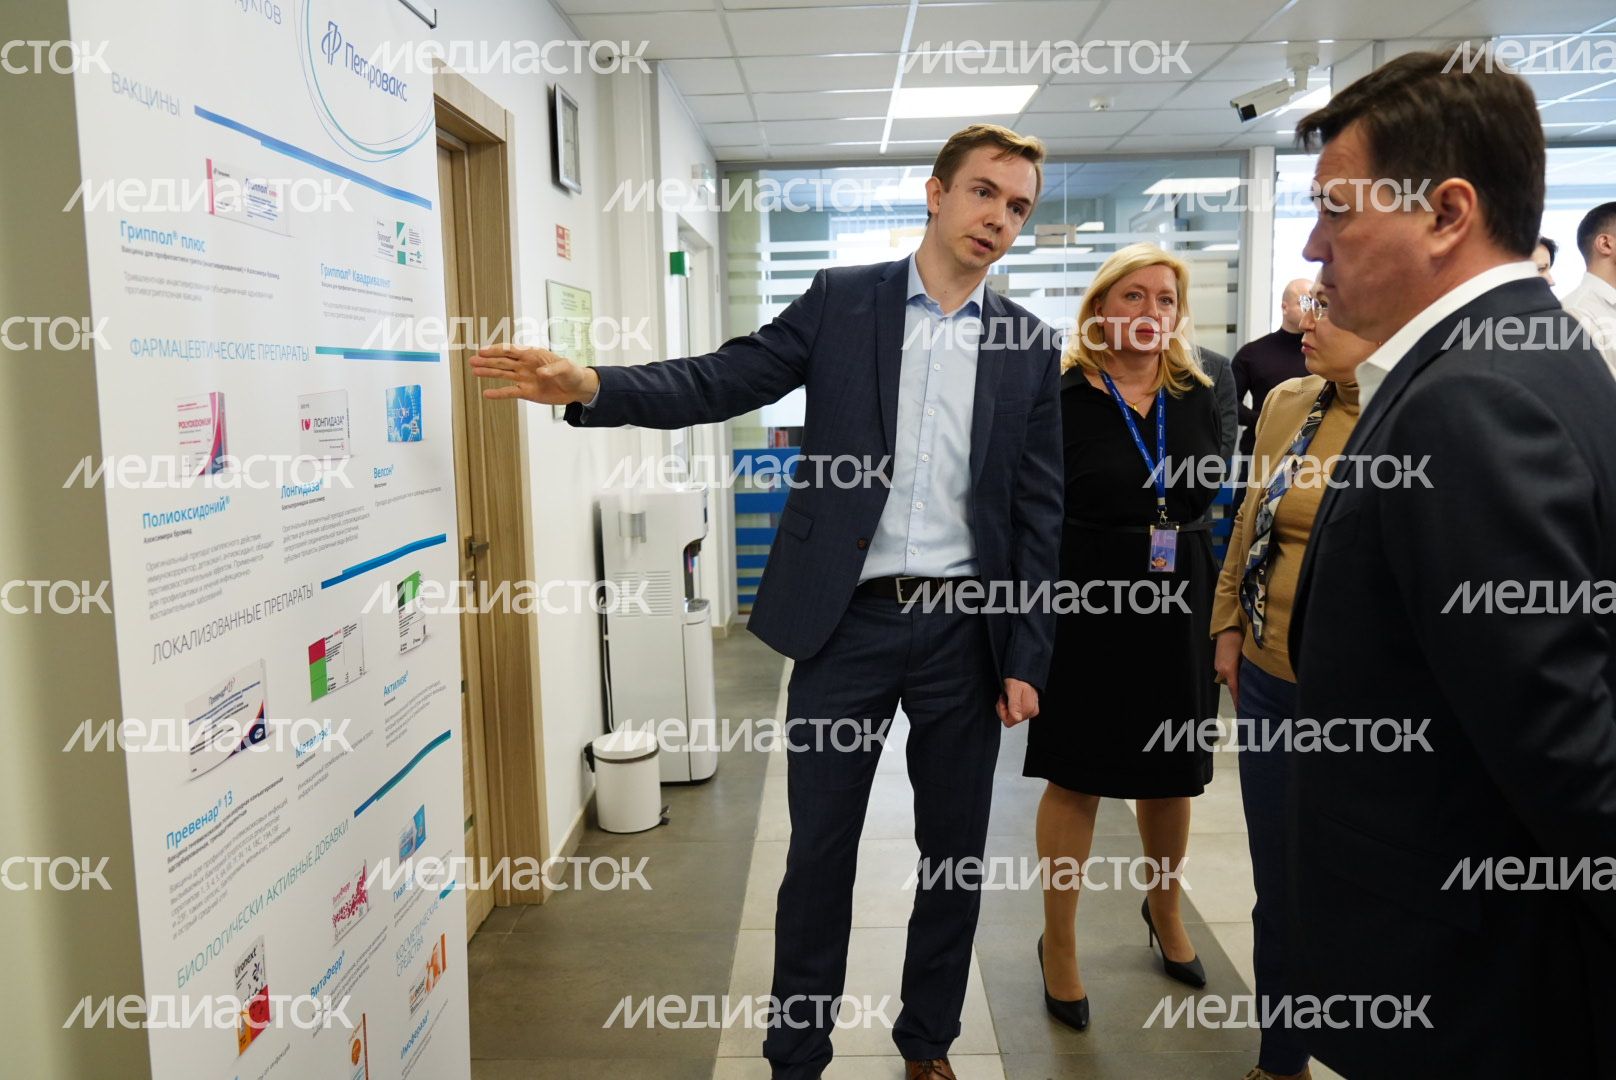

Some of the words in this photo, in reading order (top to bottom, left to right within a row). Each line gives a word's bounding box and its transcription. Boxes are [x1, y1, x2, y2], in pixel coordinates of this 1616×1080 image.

[111, 71, 181, 117] ВАКЦИНЫ
[345, 42, 408, 102] Петровакс
[181, 235, 206, 253] плюс
[130, 337, 256, 361] ФАРМАЦЕВТИЧЕСКИЕ
[257, 343, 311, 362] ПРЕПАРАТЫ
[152, 603, 262, 665] ЛОКАЛИЗОВАННЫЕ
[263, 583, 314, 617] ПРЕПАРАТЫ
[224, 790, 233, 809] 13
[177, 893, 264, 989] БИОЛОГИЧЕСКИ
[266, 851, 313, 906] АКТИВНЫЕ
[314, 819, 349, 864] ДОБАВКИ
